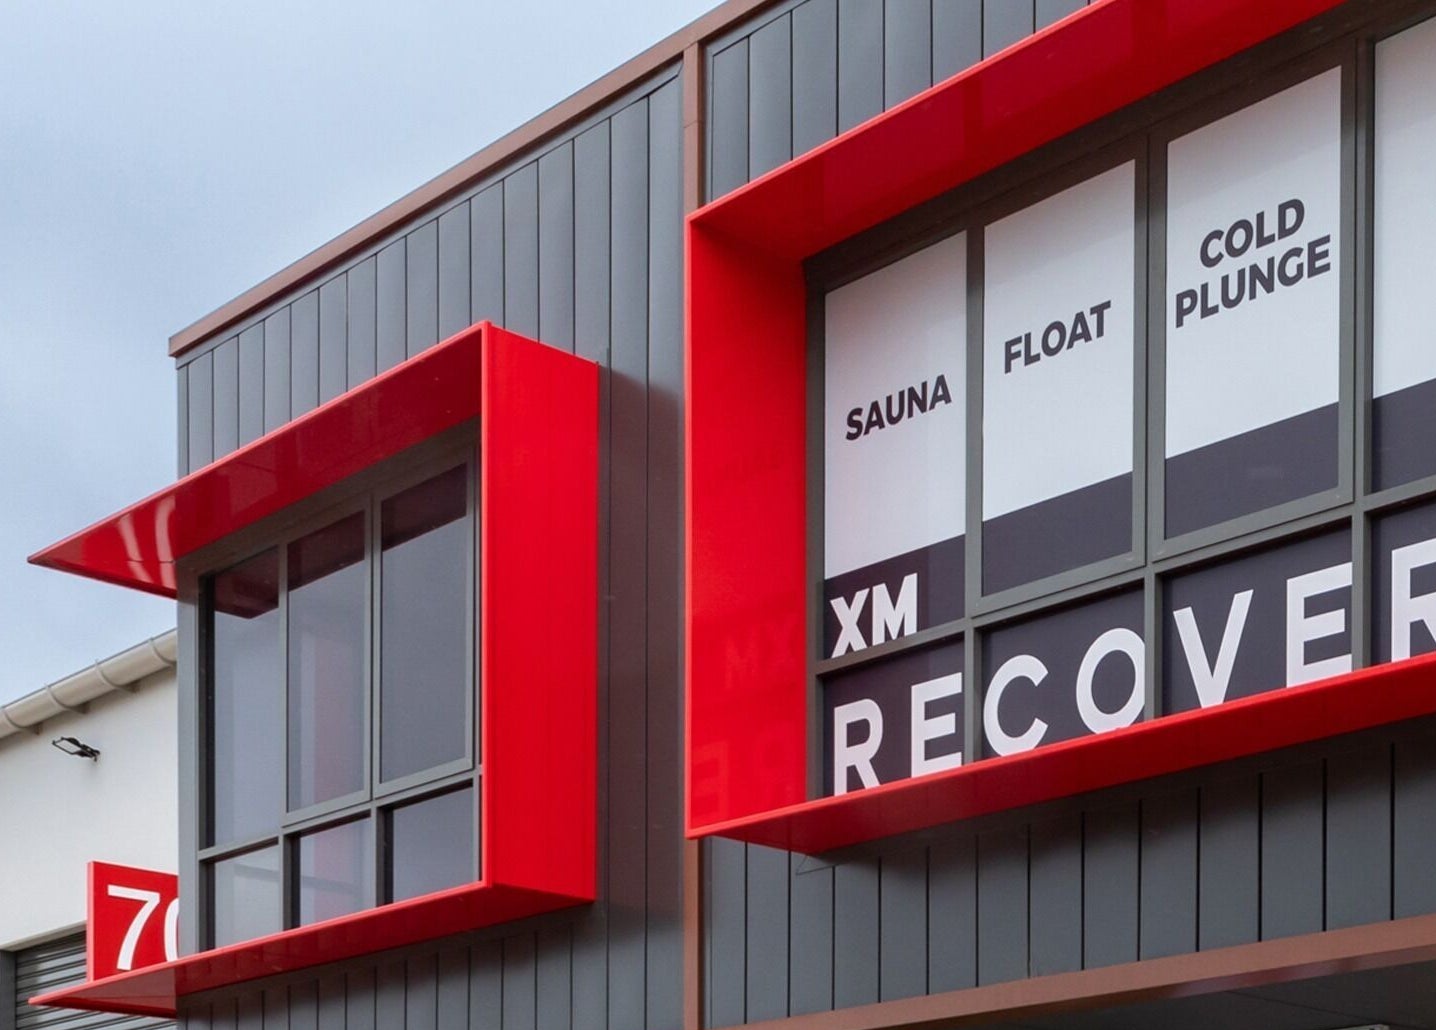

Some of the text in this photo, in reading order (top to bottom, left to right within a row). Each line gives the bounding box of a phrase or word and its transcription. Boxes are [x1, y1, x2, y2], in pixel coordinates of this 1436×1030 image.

[1199, 198, 1306, 268] COLD
[1175, 234, 1332, 329] PLUNGE
[1004, 300, 1111, 375] FLOAT
[845, 373, 953, 442] SAUNA
[830, 573, 919, 660] XM
